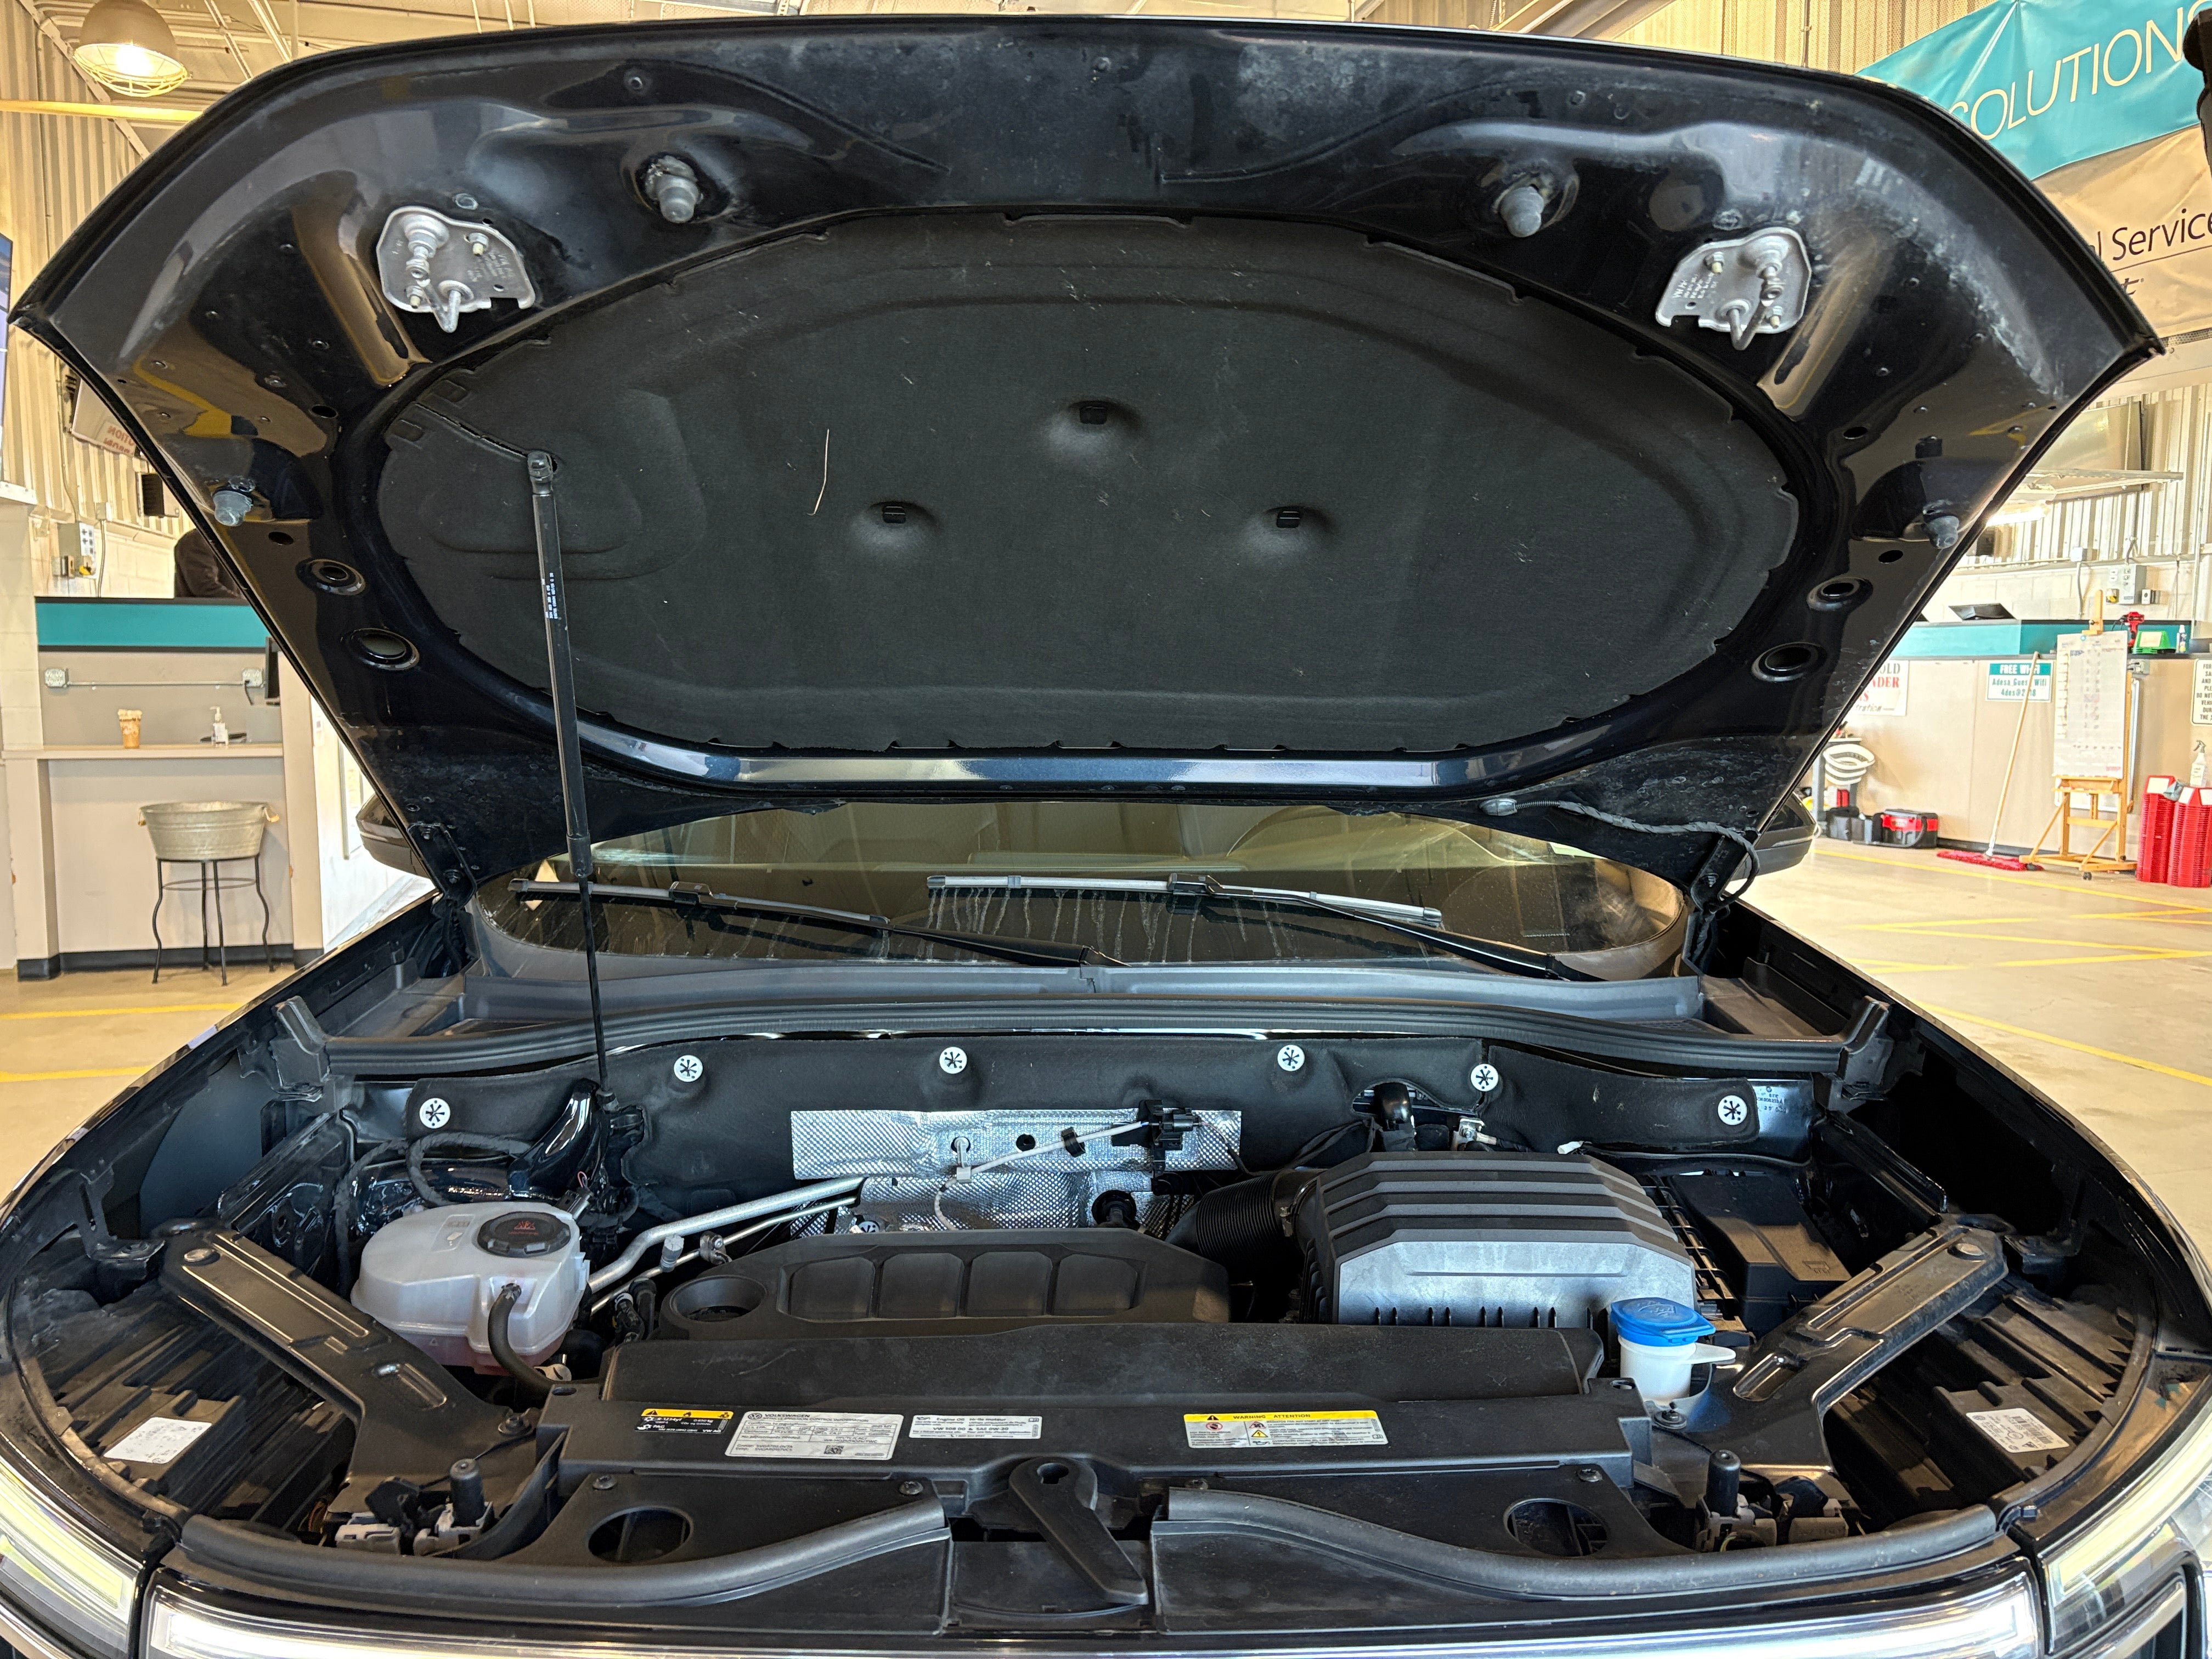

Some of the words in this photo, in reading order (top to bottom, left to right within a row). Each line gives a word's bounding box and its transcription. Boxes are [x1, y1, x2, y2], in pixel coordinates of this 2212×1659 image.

[2112, 208, 2212, 261] Servic
[2000, 664, 2017, 674] FREE
[2019, 664, 2040, 674] WIFI
